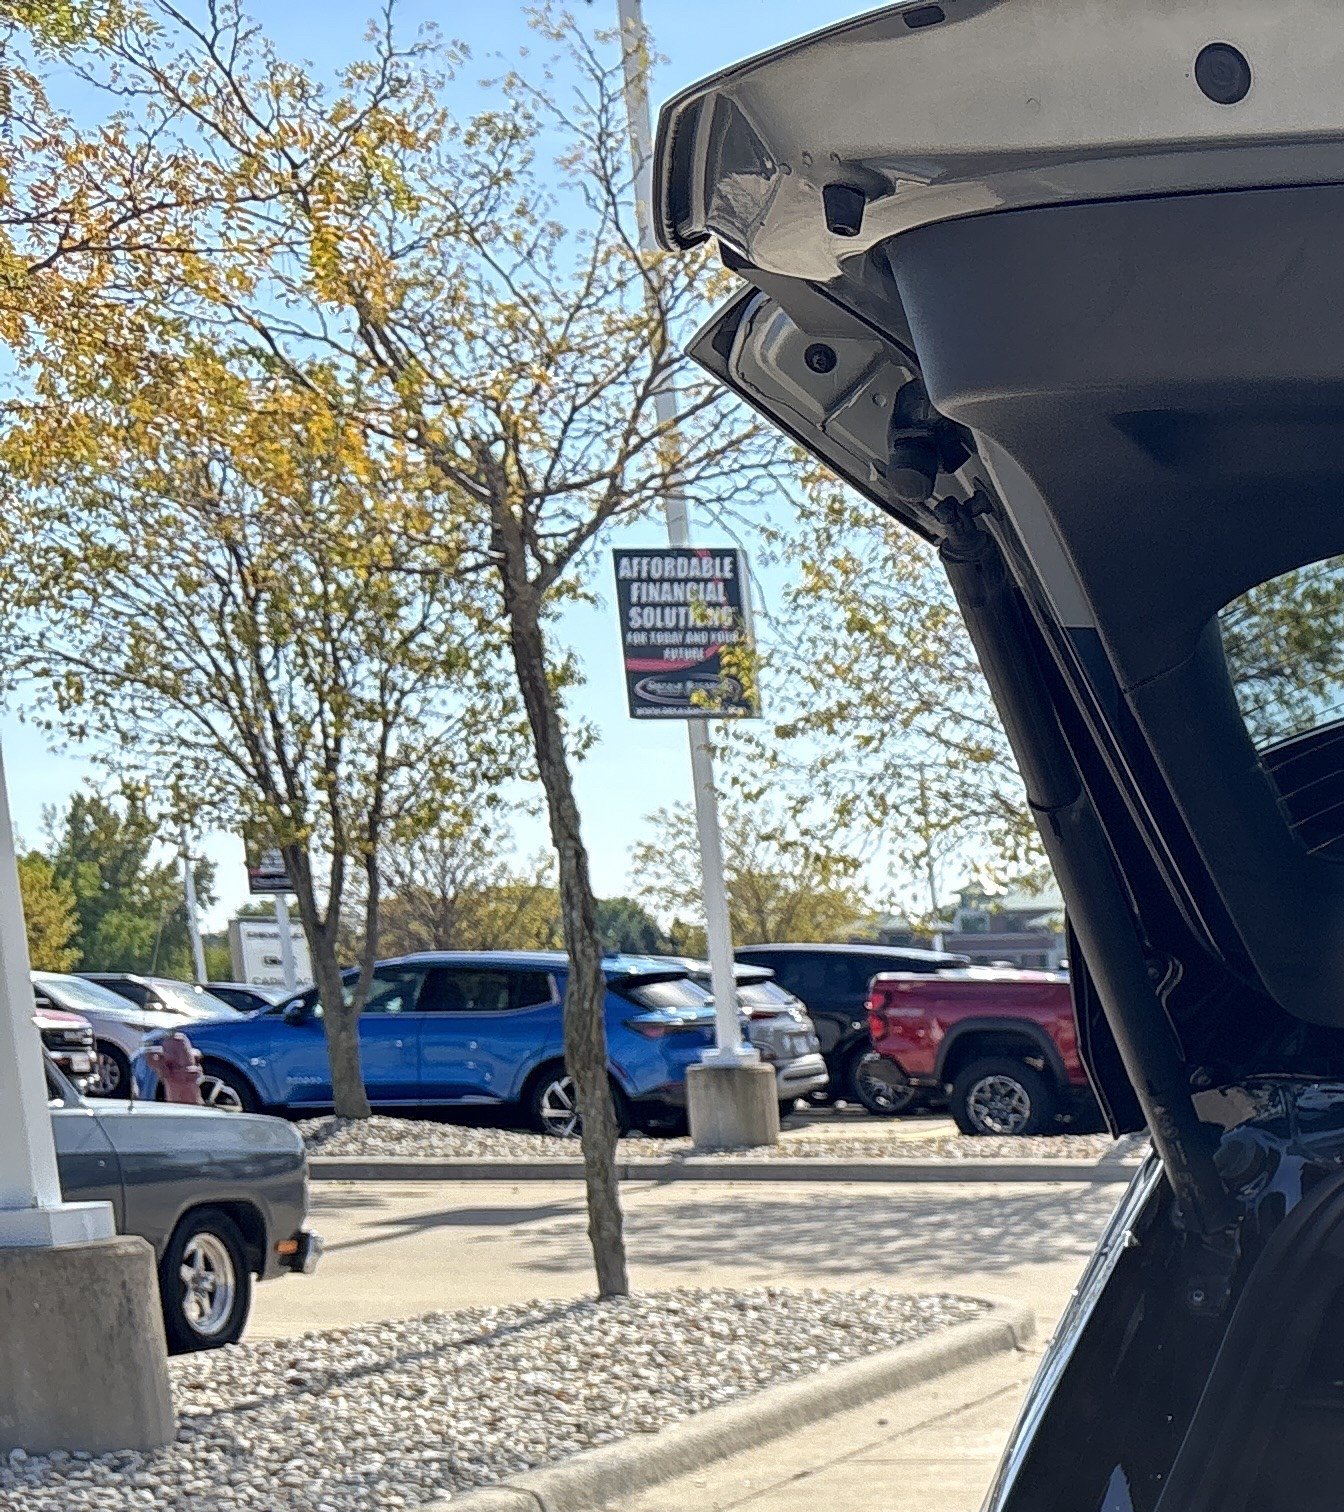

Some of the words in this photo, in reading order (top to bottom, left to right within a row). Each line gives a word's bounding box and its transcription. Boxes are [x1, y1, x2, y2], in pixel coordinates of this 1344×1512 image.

[618, 556, 734, 579] AFFORDABLE
[630, 581, 726, 604] FINANCIAL
[625, 631, 649, 646] FOR
[649, 630, 683, 645] TODAY
[684, 630, 709, 645] AND
